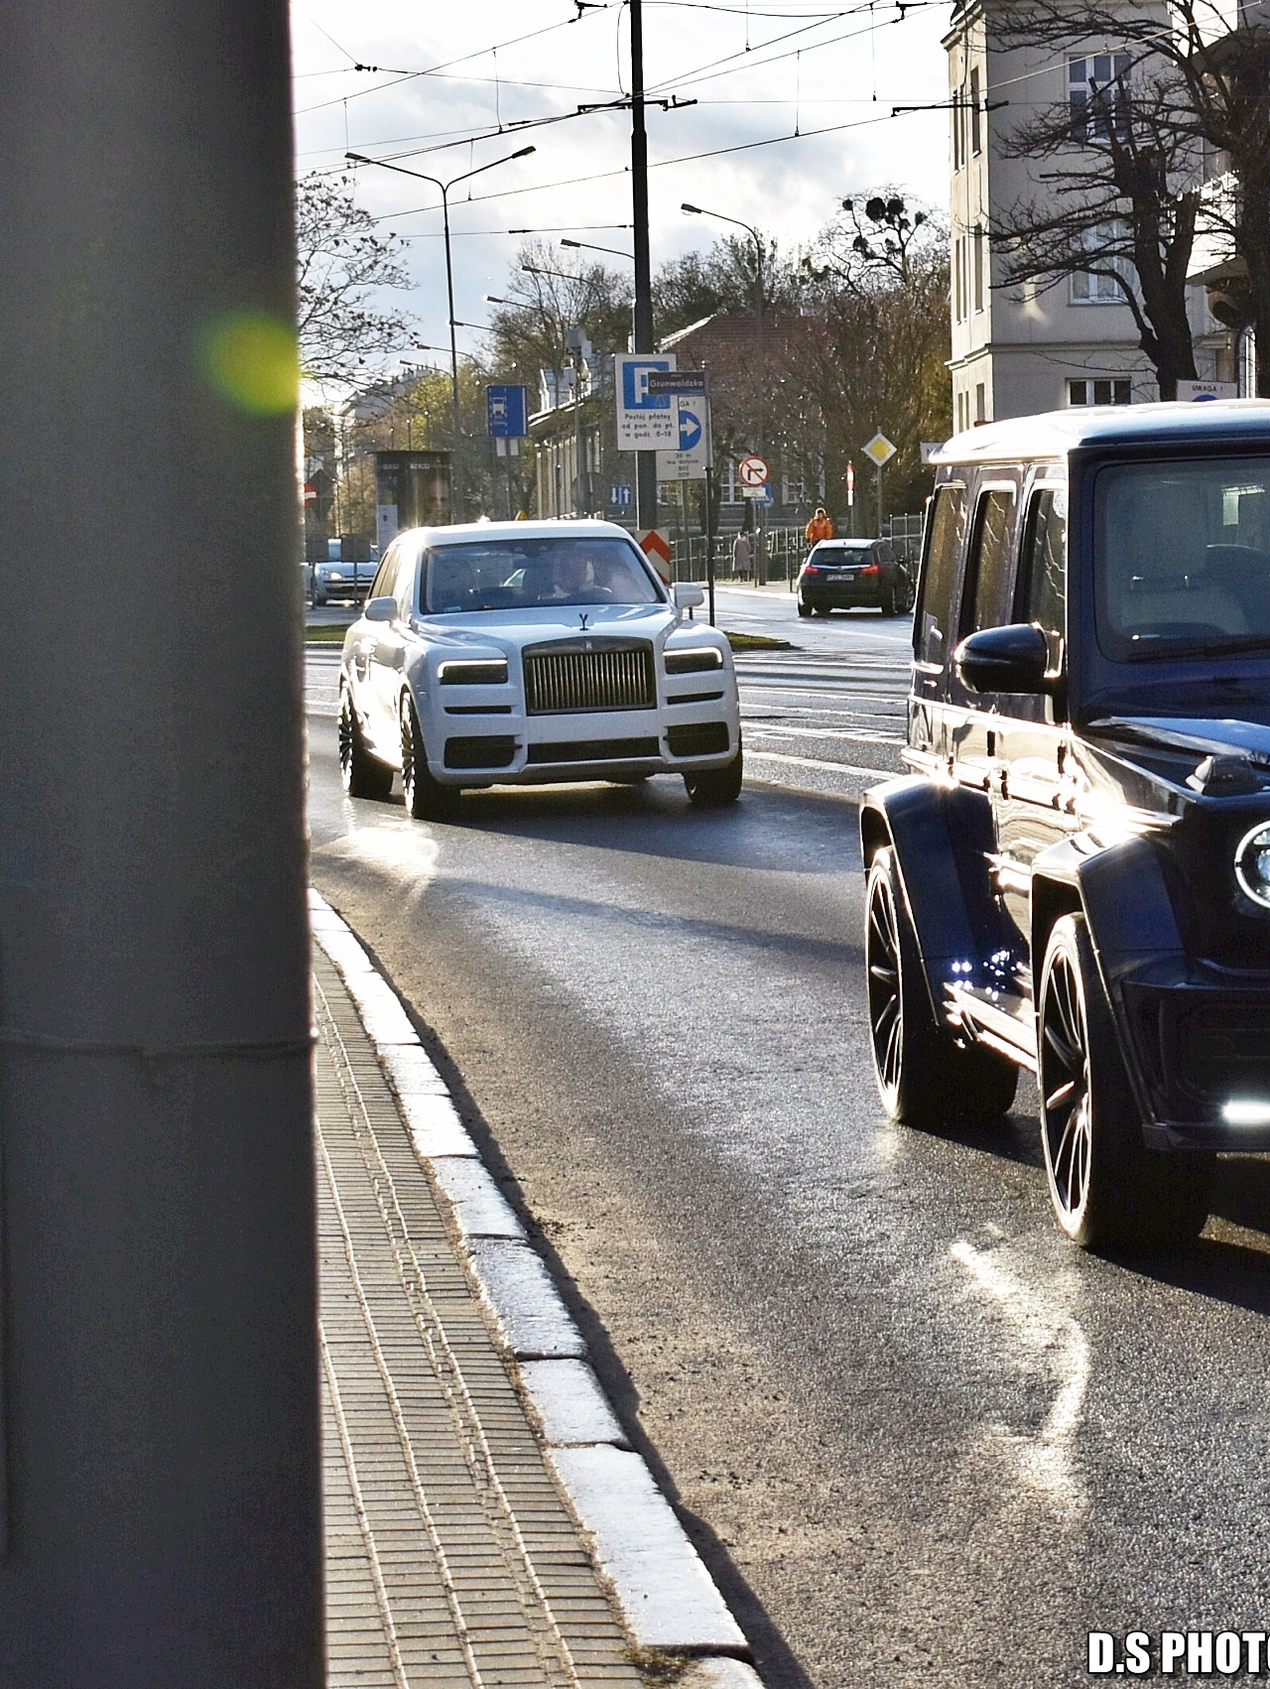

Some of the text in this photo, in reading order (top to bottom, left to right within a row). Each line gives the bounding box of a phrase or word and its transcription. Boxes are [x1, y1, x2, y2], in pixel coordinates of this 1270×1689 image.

[649, 379, 704, 388] Grunwaldzka
[624, 413, 671, 422] Postój płatny
